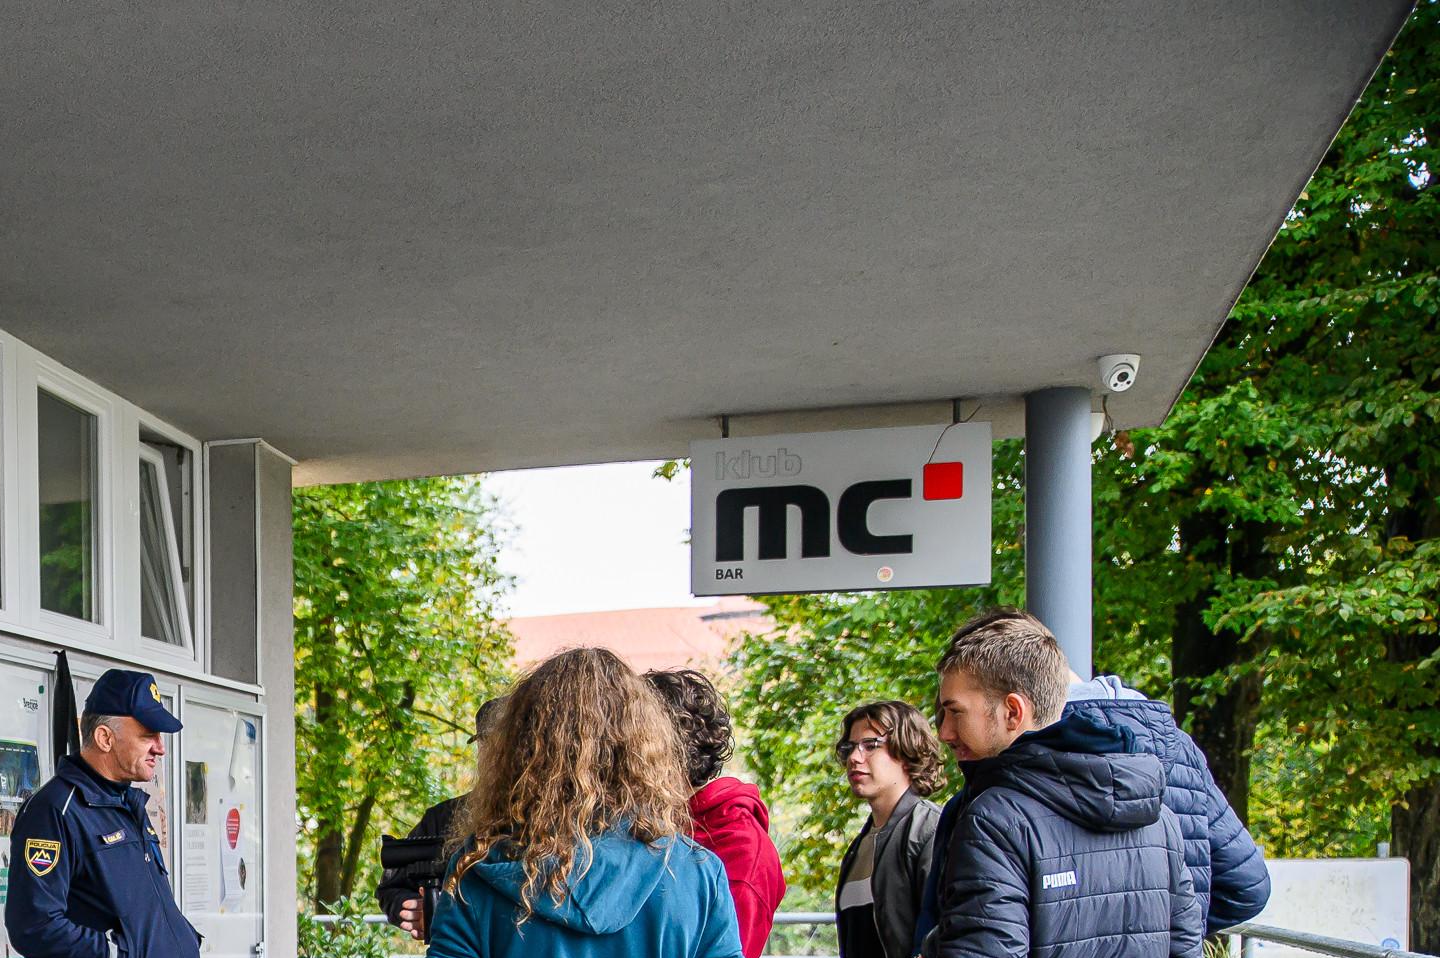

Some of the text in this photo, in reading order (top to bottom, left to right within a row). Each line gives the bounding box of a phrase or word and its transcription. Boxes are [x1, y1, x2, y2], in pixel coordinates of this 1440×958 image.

[715, 448, 802, 481] klub
[715, 478, 914, 562] mc
[715, 567, 744, 580] BAR
[29, 841, 57, 850] POLICIJA
[1042, 870, 1077, 890] PUMA
